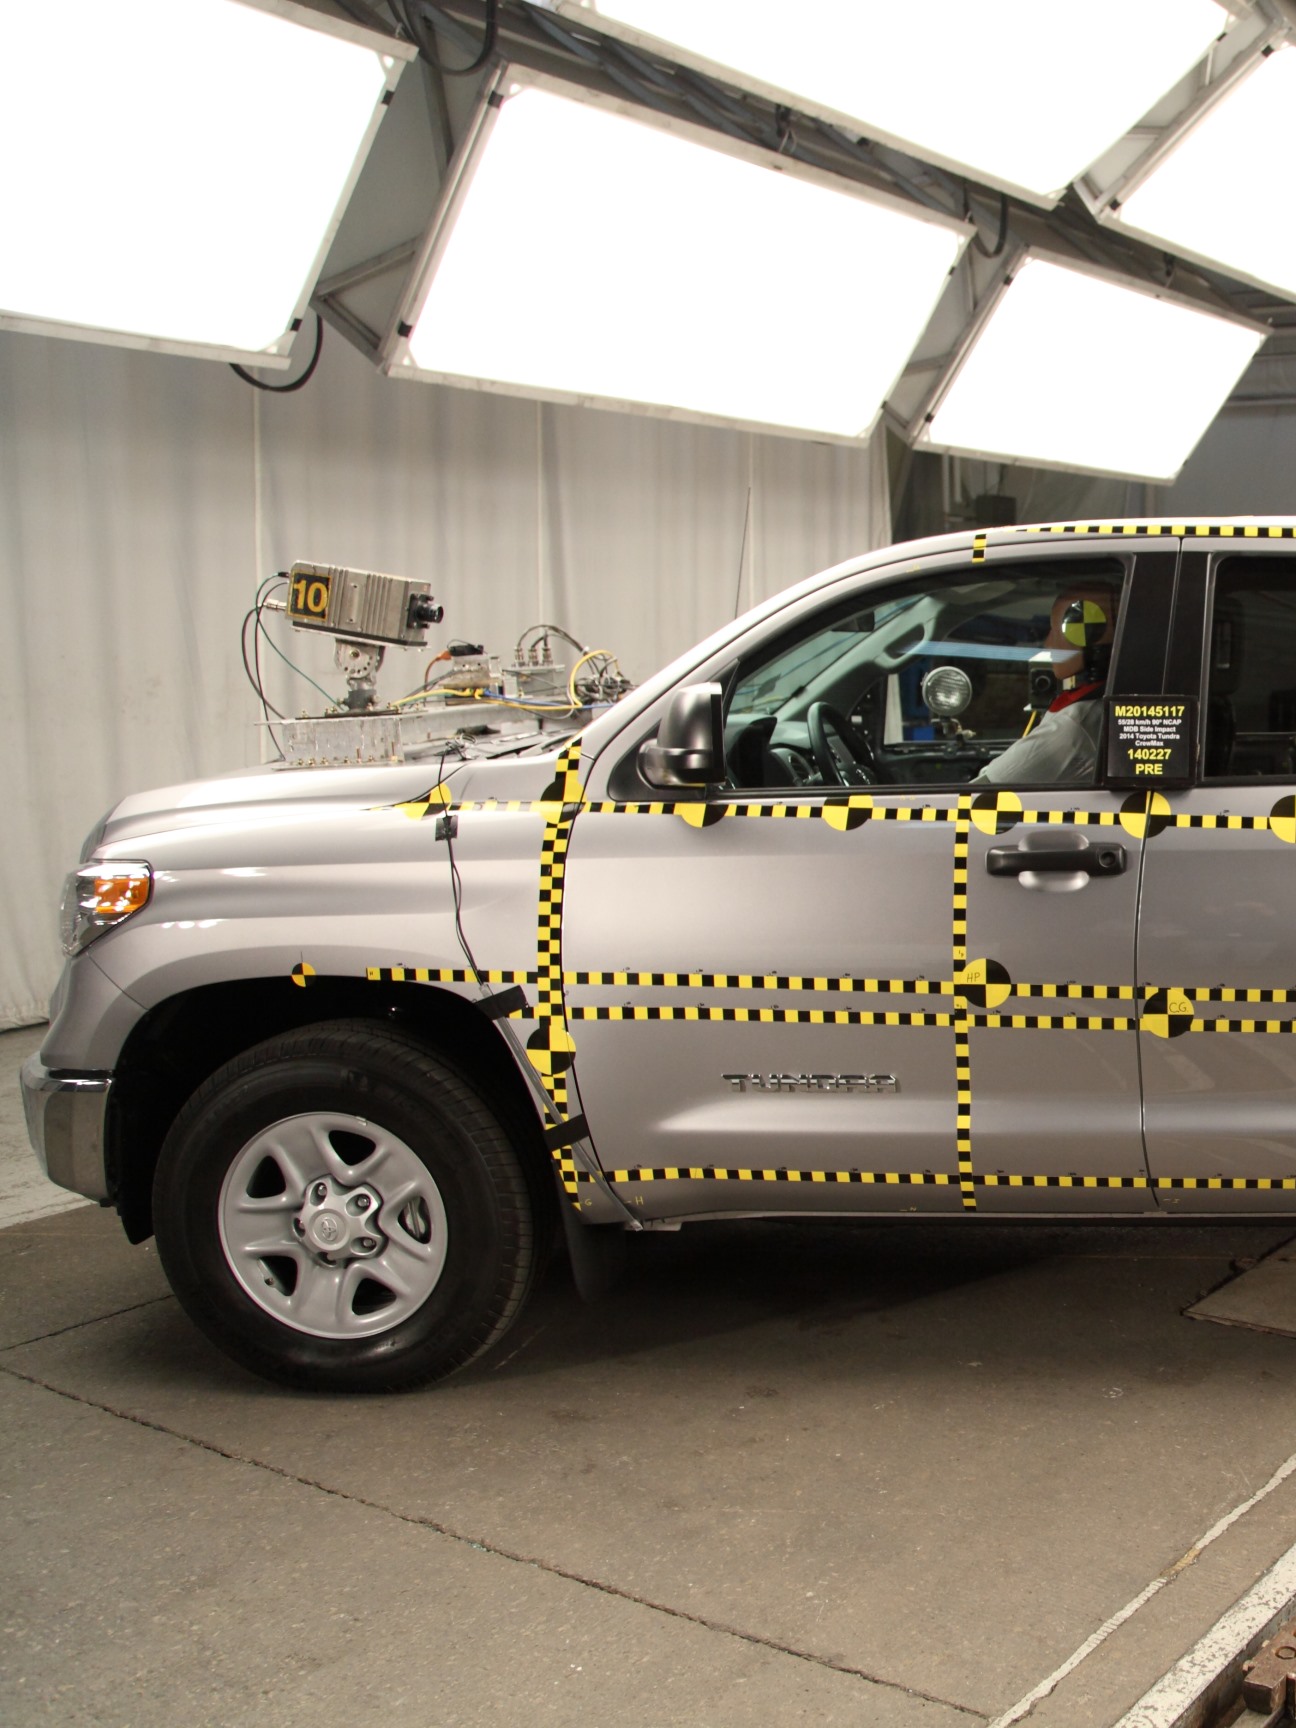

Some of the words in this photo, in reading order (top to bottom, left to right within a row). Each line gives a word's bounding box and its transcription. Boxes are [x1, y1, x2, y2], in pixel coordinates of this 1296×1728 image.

[293, 579, 328, 613] 10
[1115, 705, 1185, 717] M20145117
[1155, 726, 1176, 734] Impact
[1136, 733, 1157, 741] Toyota
[1128, 749, 1172, 760] 140227
[1136, 764, 1163, 775] PRE
[966, 971, 981, 984] HP
[721, 1073, 902, 1093] TUNDRA
